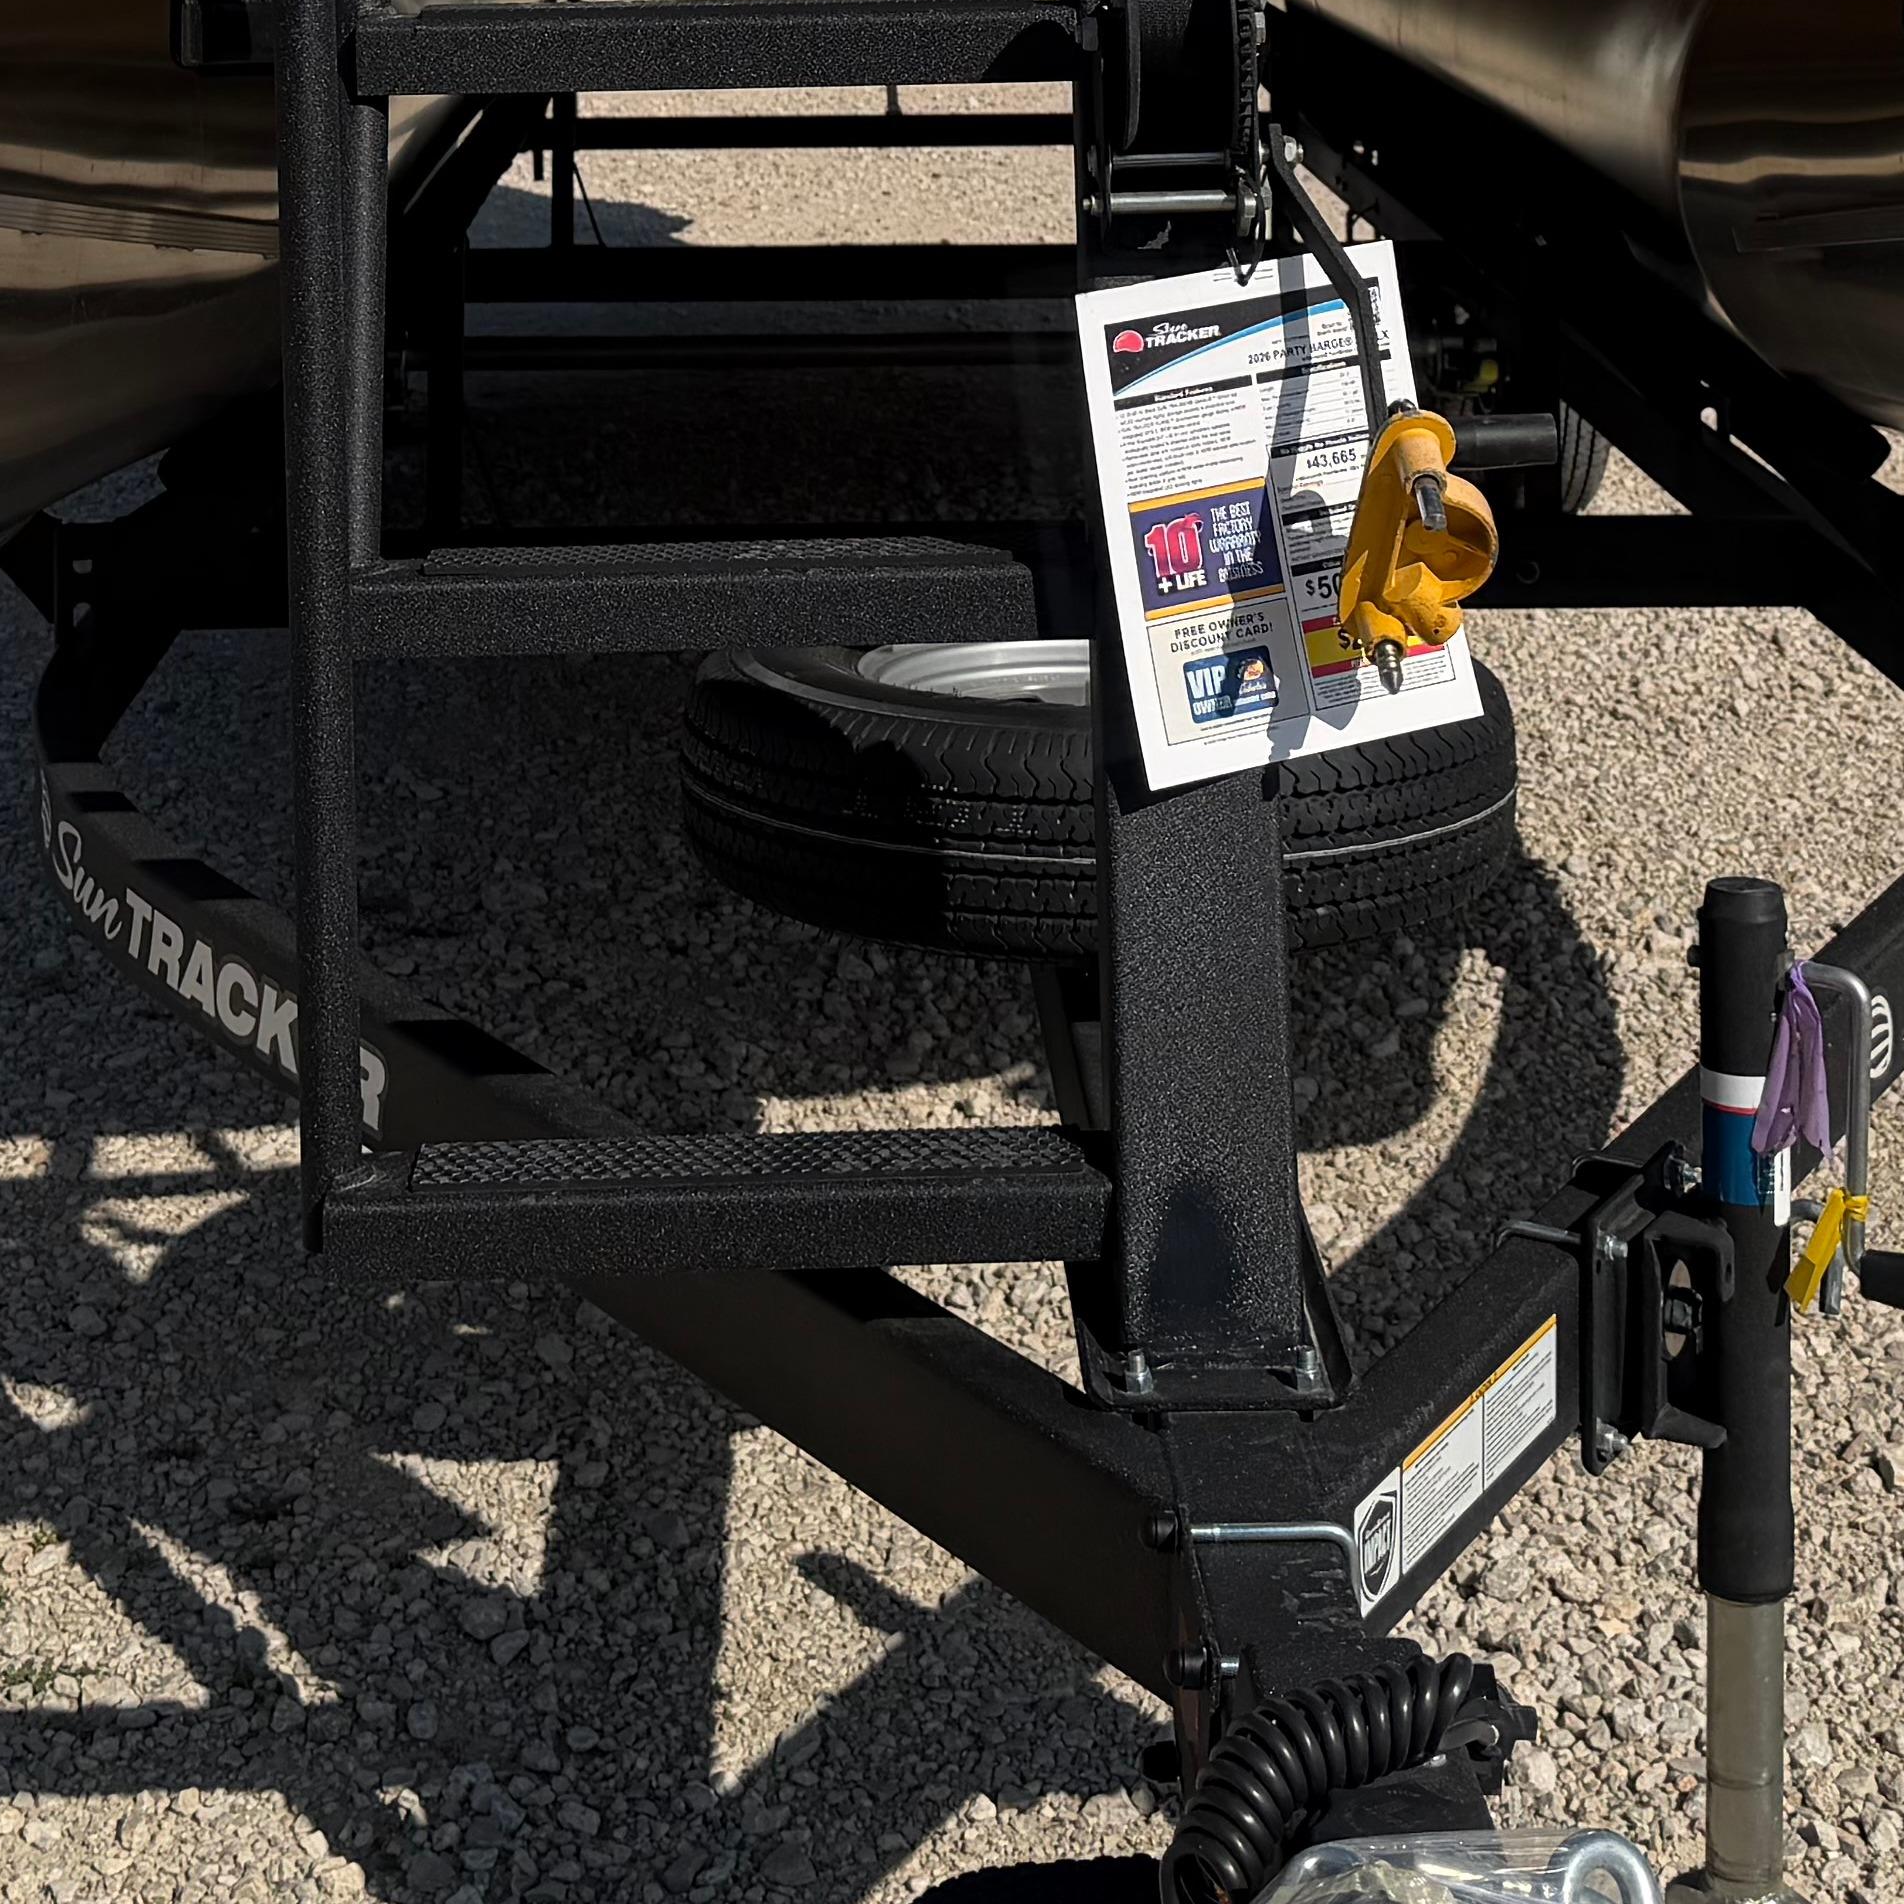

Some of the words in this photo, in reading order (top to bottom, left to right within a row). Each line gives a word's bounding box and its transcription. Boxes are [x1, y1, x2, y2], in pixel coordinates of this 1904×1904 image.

[1146, 325, 1222, 348] TRACKER
[1273, 345, 1308, 360] PARTY
[1209, 507, 1228, 520] THE
[1229, 500, 1251, 517] BEST
[1212, 516, 1254, 537] FACTORY
[1209, 530, 1262, 553] WARRANTY
[1223, 551, 1234, 566] IN
[1235, 546, 1254, 563] THE
[1175, 569, 1208, 591] LIFE
[1174, 623, 1206, 640] FREE
[1208, 611, 1265, 631] OWNER'S
[1170, 629, 1231, 653] DISCOUNT
[1235, 622, 1274, 639] CARD!
[1185, 664, 1227, 700] VIP
[52, 820, 123, 940] Sun
[125, 887, 387, 1132] TRACKR
